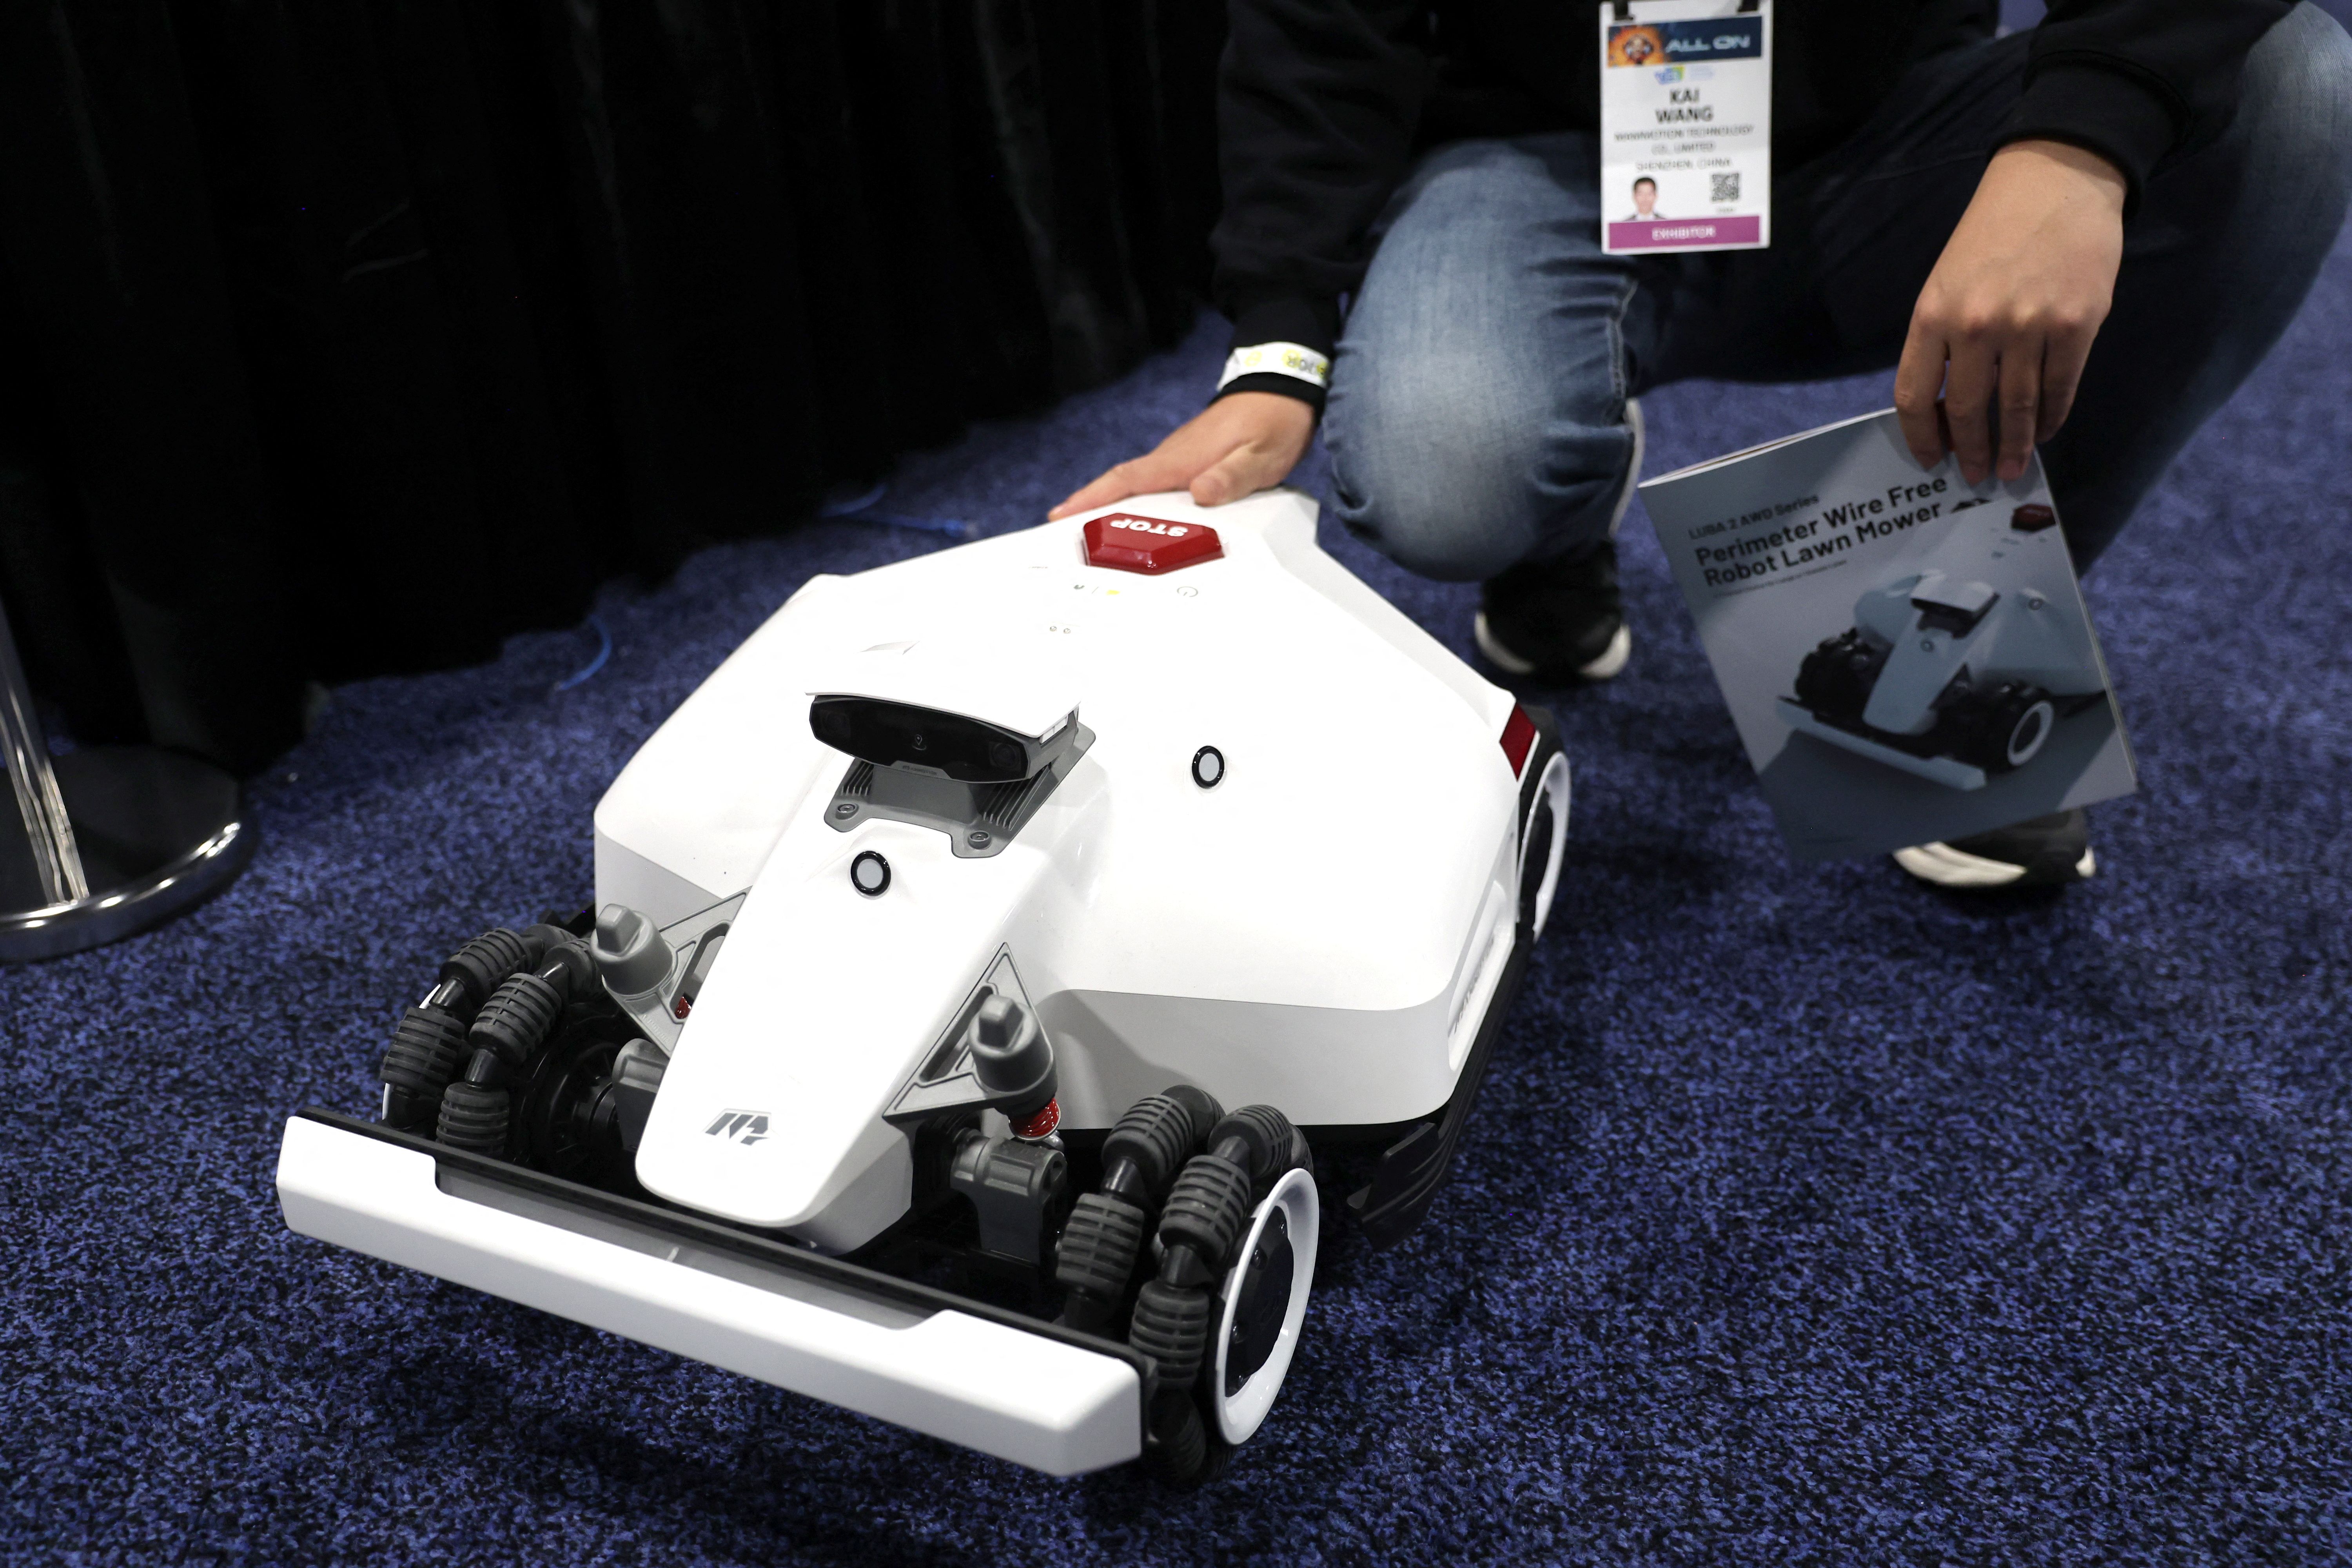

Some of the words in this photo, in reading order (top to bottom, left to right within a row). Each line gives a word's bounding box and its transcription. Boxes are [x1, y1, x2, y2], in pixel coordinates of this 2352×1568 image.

[1665, 37, 1711, 53] ALL
[1713, 34, 1750, 50] ON
[1670, 88, 1700, 103] KAI
[1655, 105, 1713, 123] WANG
[1774, 494, 1820, 516] Series
[1110, 519, 1188, 537] STOP
[1695, 517, 1819, 566] Perimeter
[1823, 496, 1884, 529] Wire
[1887, 477, 1947, 507] Free
[1704, 555, 1777, 587] Robot
[1782, 535, 1852, 567] Lawn
[1856, 502, 1942, 544] Mower
